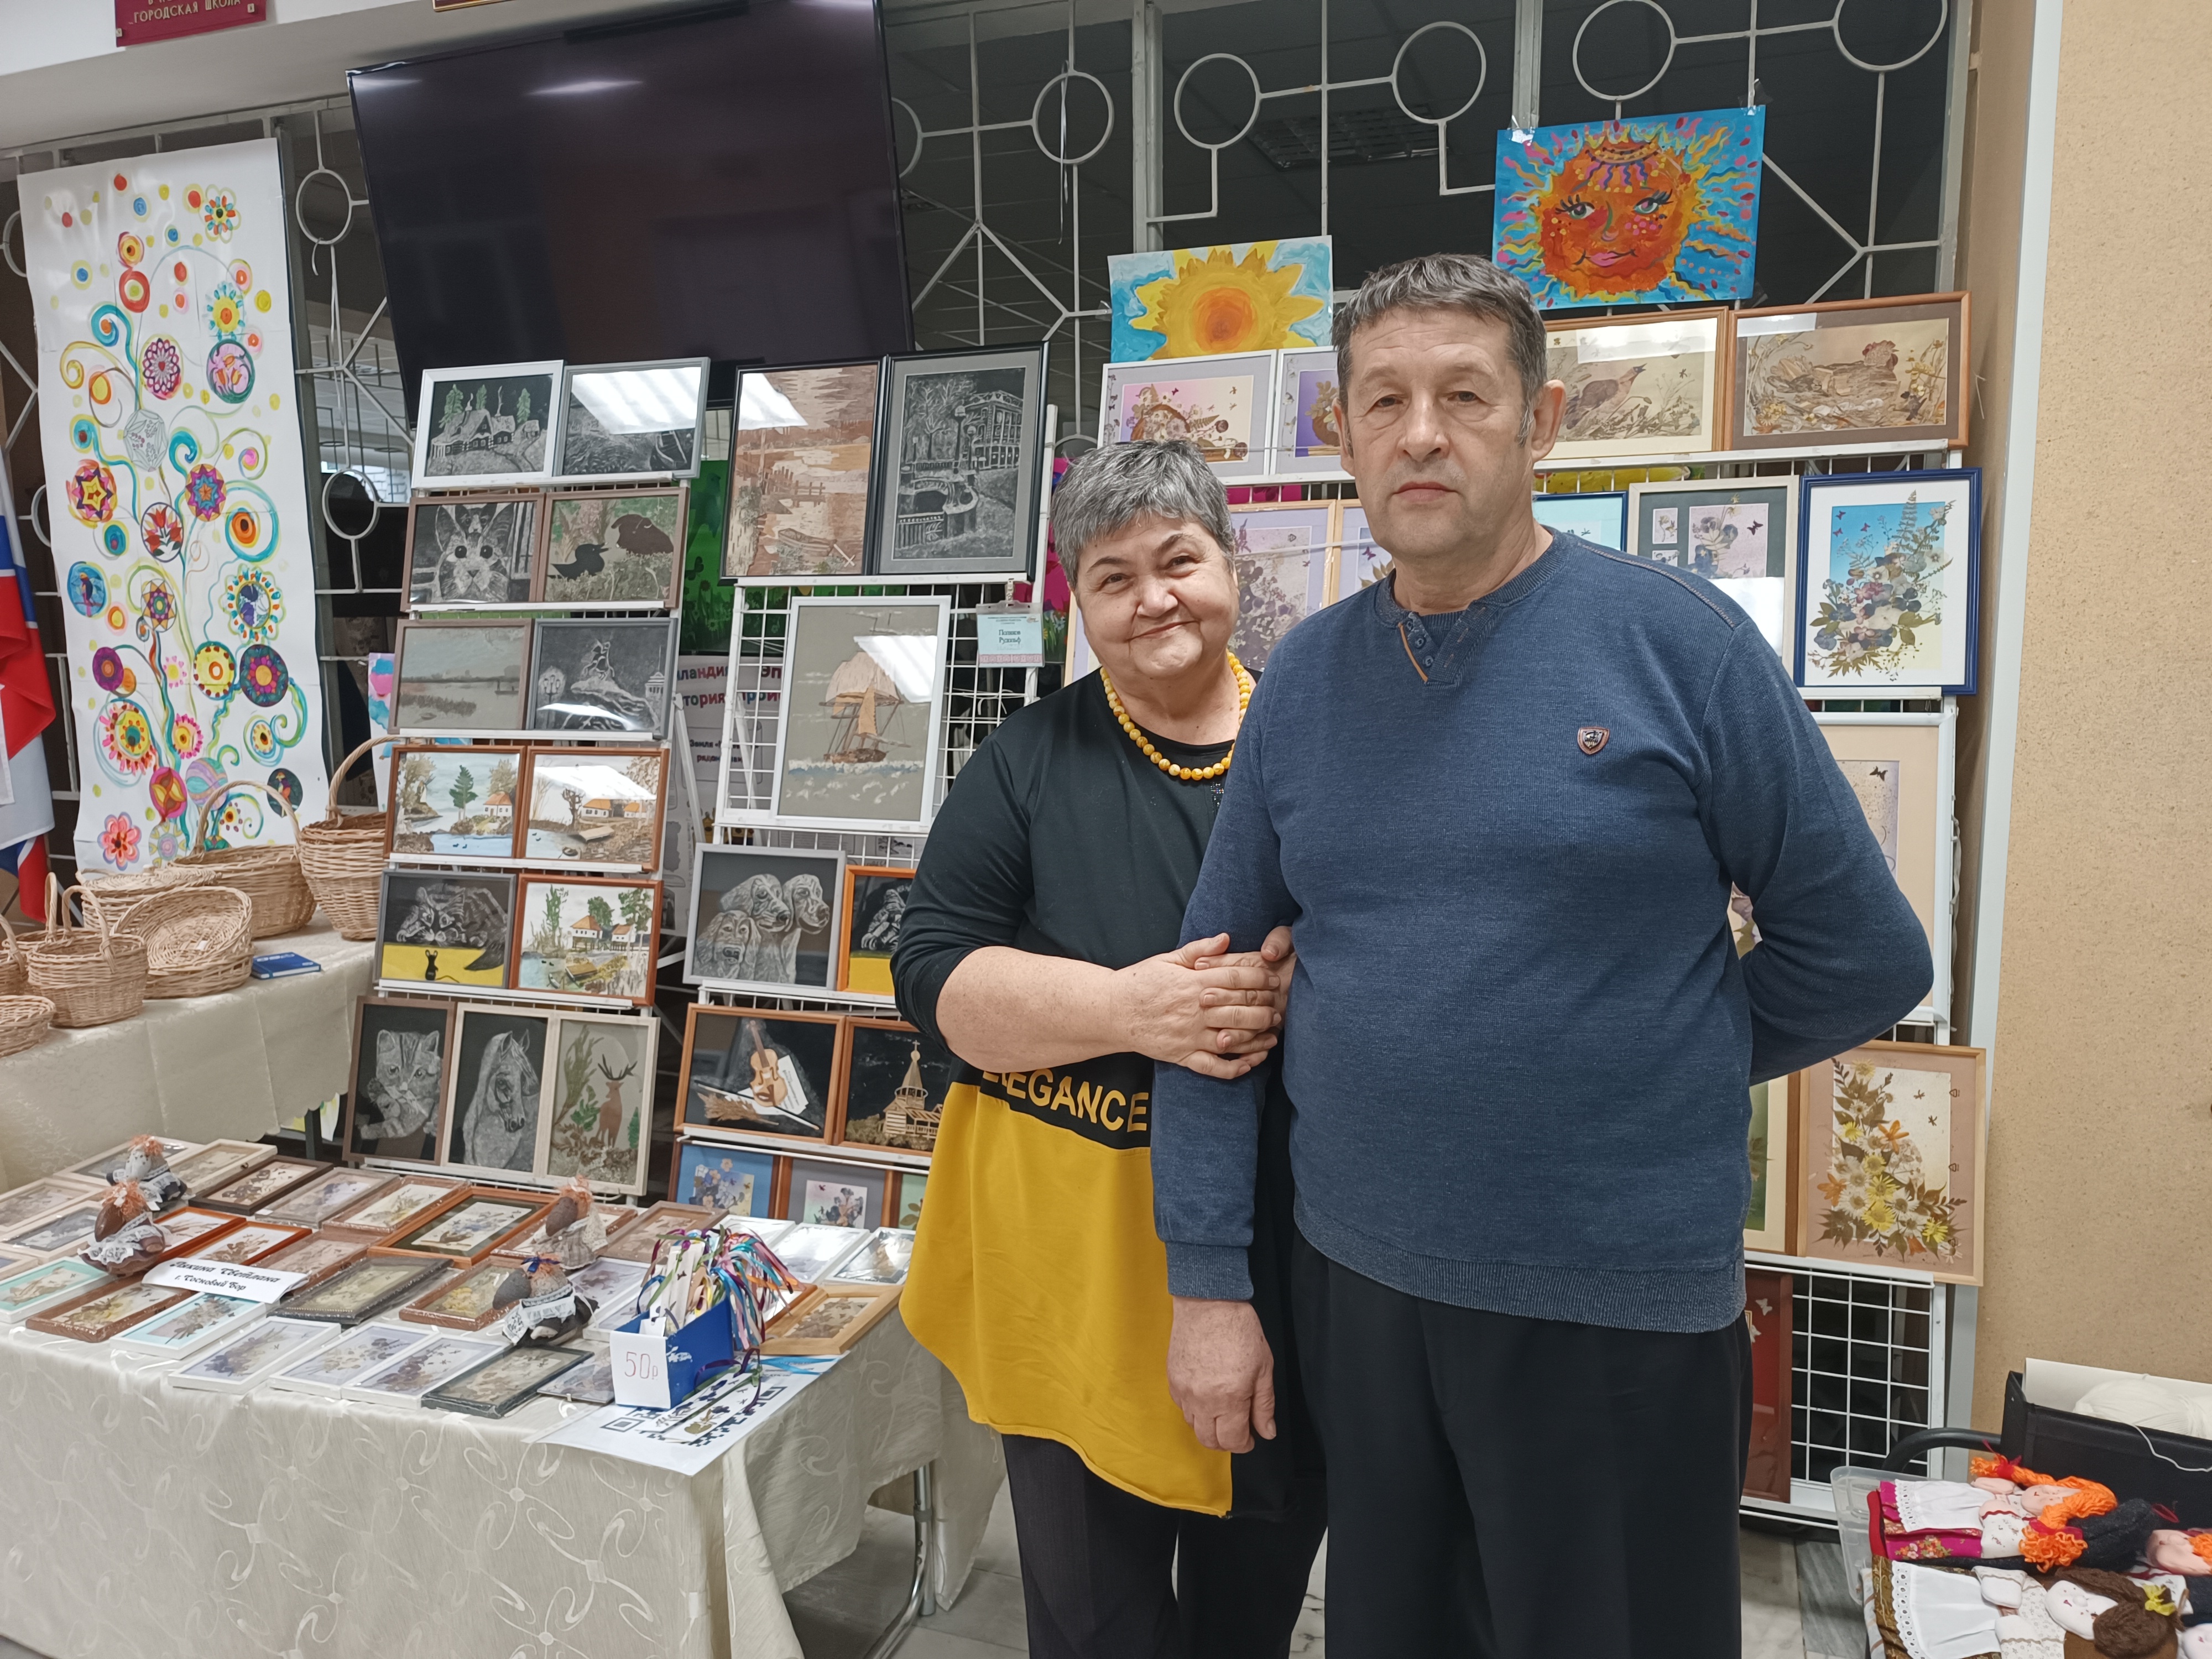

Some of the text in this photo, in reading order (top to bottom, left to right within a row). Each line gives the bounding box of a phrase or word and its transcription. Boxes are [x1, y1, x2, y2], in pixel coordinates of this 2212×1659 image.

[682, 693, 725, 708] тория
[982, 1068, 1149, 1133] EGANCE
[184, 1275, 228, 1287] Сосновый
[229, 1281, 247, 1291] Бор
